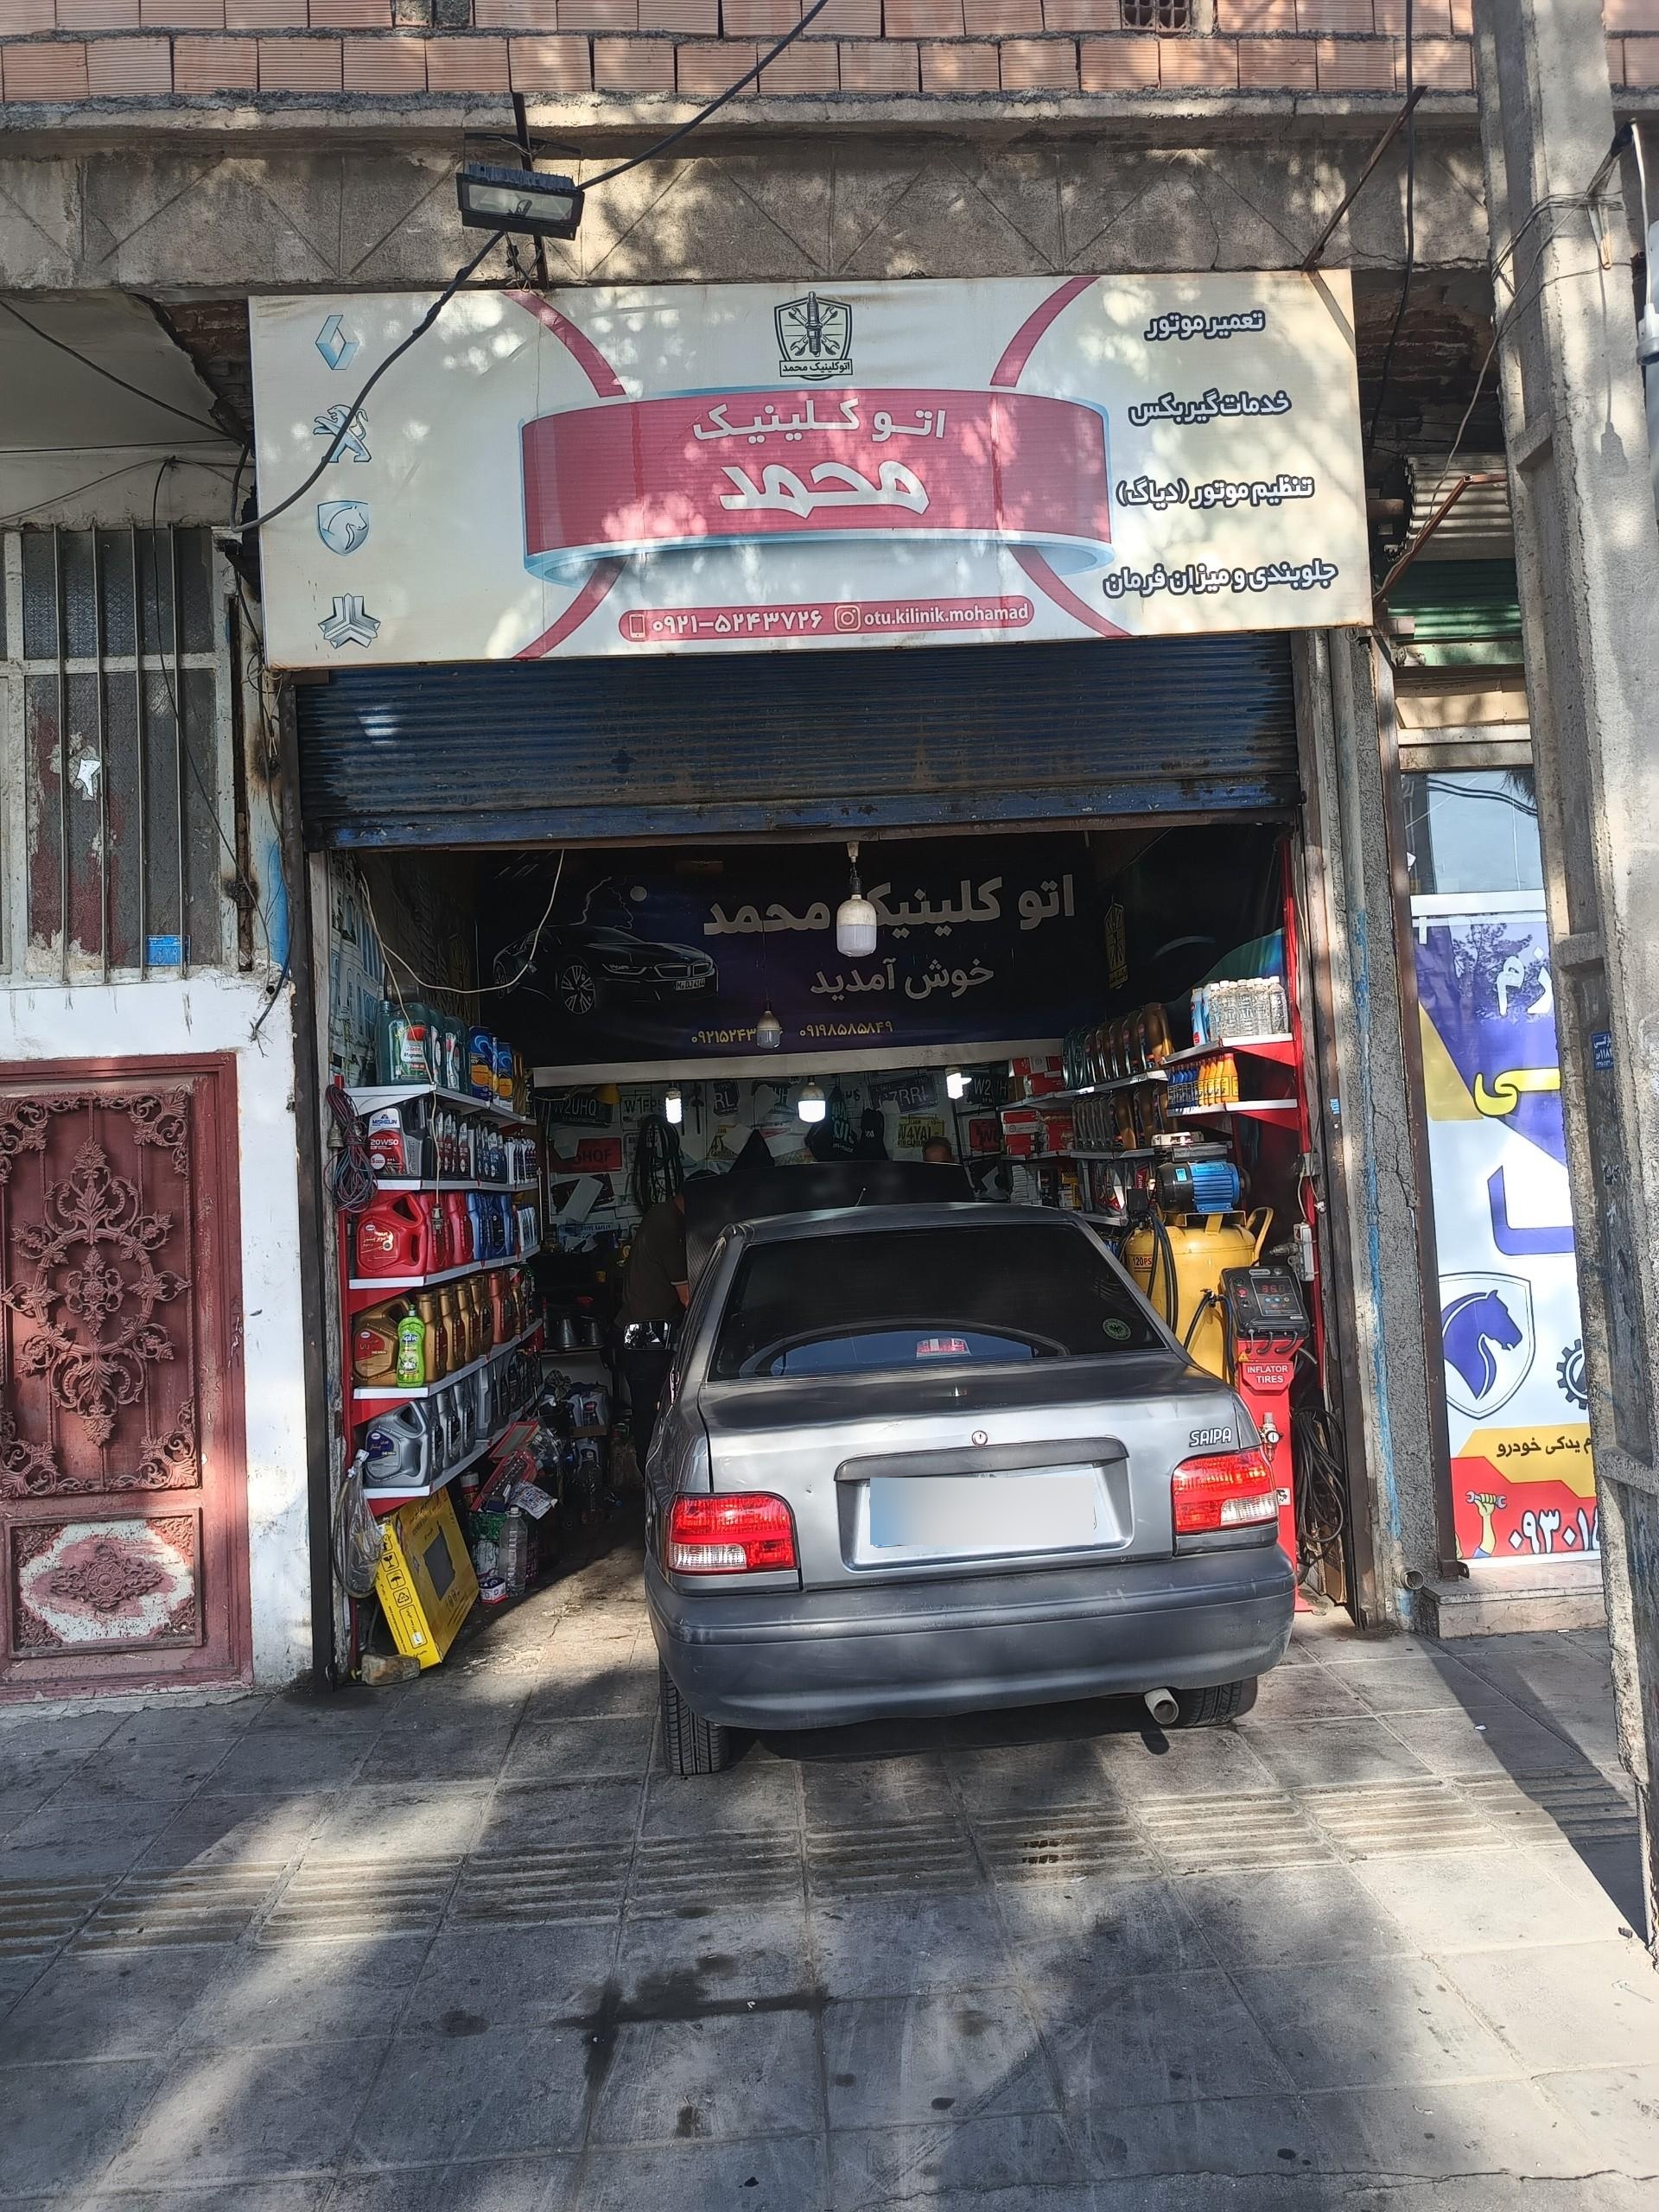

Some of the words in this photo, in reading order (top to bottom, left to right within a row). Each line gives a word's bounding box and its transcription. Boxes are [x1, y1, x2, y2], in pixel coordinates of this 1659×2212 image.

[1144, 313, 1204, 340] موتور
[1206, 310, 1267, 339] تعمیر
[782, 364, 808, 372] محمد
[1128, 389, 1218, 426] گیربکس
[1216, 389, 1292, 417] خدمات
[692, 397, 861, 445] کلینیک
[872, 409, 947, 442] اتو
[718, 459, 931, 519] محمد
[1116, 476, 1189, 510] (دیاگ)
[1189, 481, 1248, 510] موتور
[1250, 475, 1314, 507] تنظیم
[1103, 563, 1166, 598] فرمان
[1169, 563, 1234, 594] میزان
[1234, 571, 1248, 594] و
[1250, 557, 1338, 592] جلوبندی
[864, 603, 1029, 627] otu.kilinik.mohamad
[703, 900, 830, 935] محمد
[1017, 874, 1076, 931] اتو
[810, 957, 898, 1001] آمدید
[904, 957, 995, 1000] خوش
[1247, 1364, 1287, 1374] INFLATOR
[1256, 1375, 1284, 1383] TIRES
[1189, 1427, 1231, 1447] SAIPA
[1497, 1437, 1541, 1458] خودرو
[1546, 1437, 1580, 1455] یدکی
